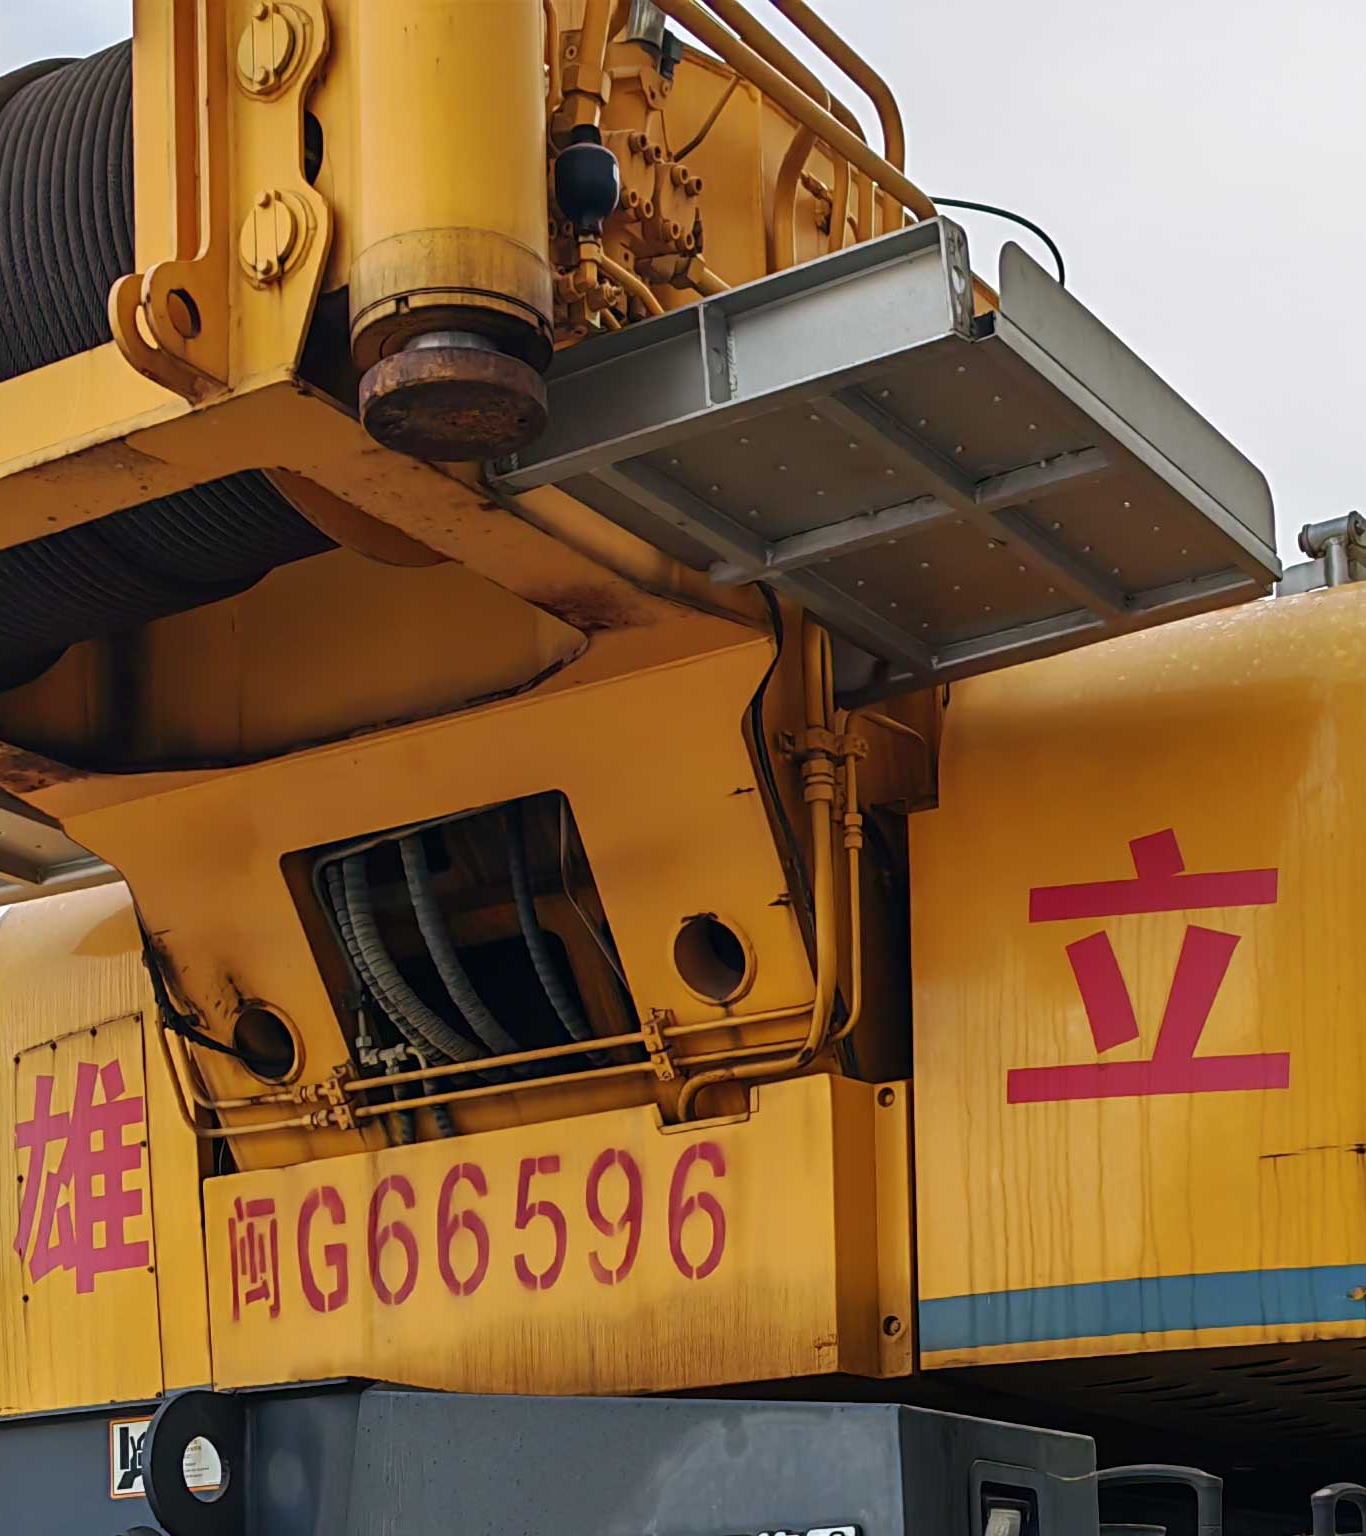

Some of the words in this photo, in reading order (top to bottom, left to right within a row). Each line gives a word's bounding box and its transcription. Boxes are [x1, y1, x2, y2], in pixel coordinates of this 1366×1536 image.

[1006, 828, 1290, 1105] 立
[14, 1058, 151, 1294] 雄
[228, 1141, 729, 1323] 闽G66596
